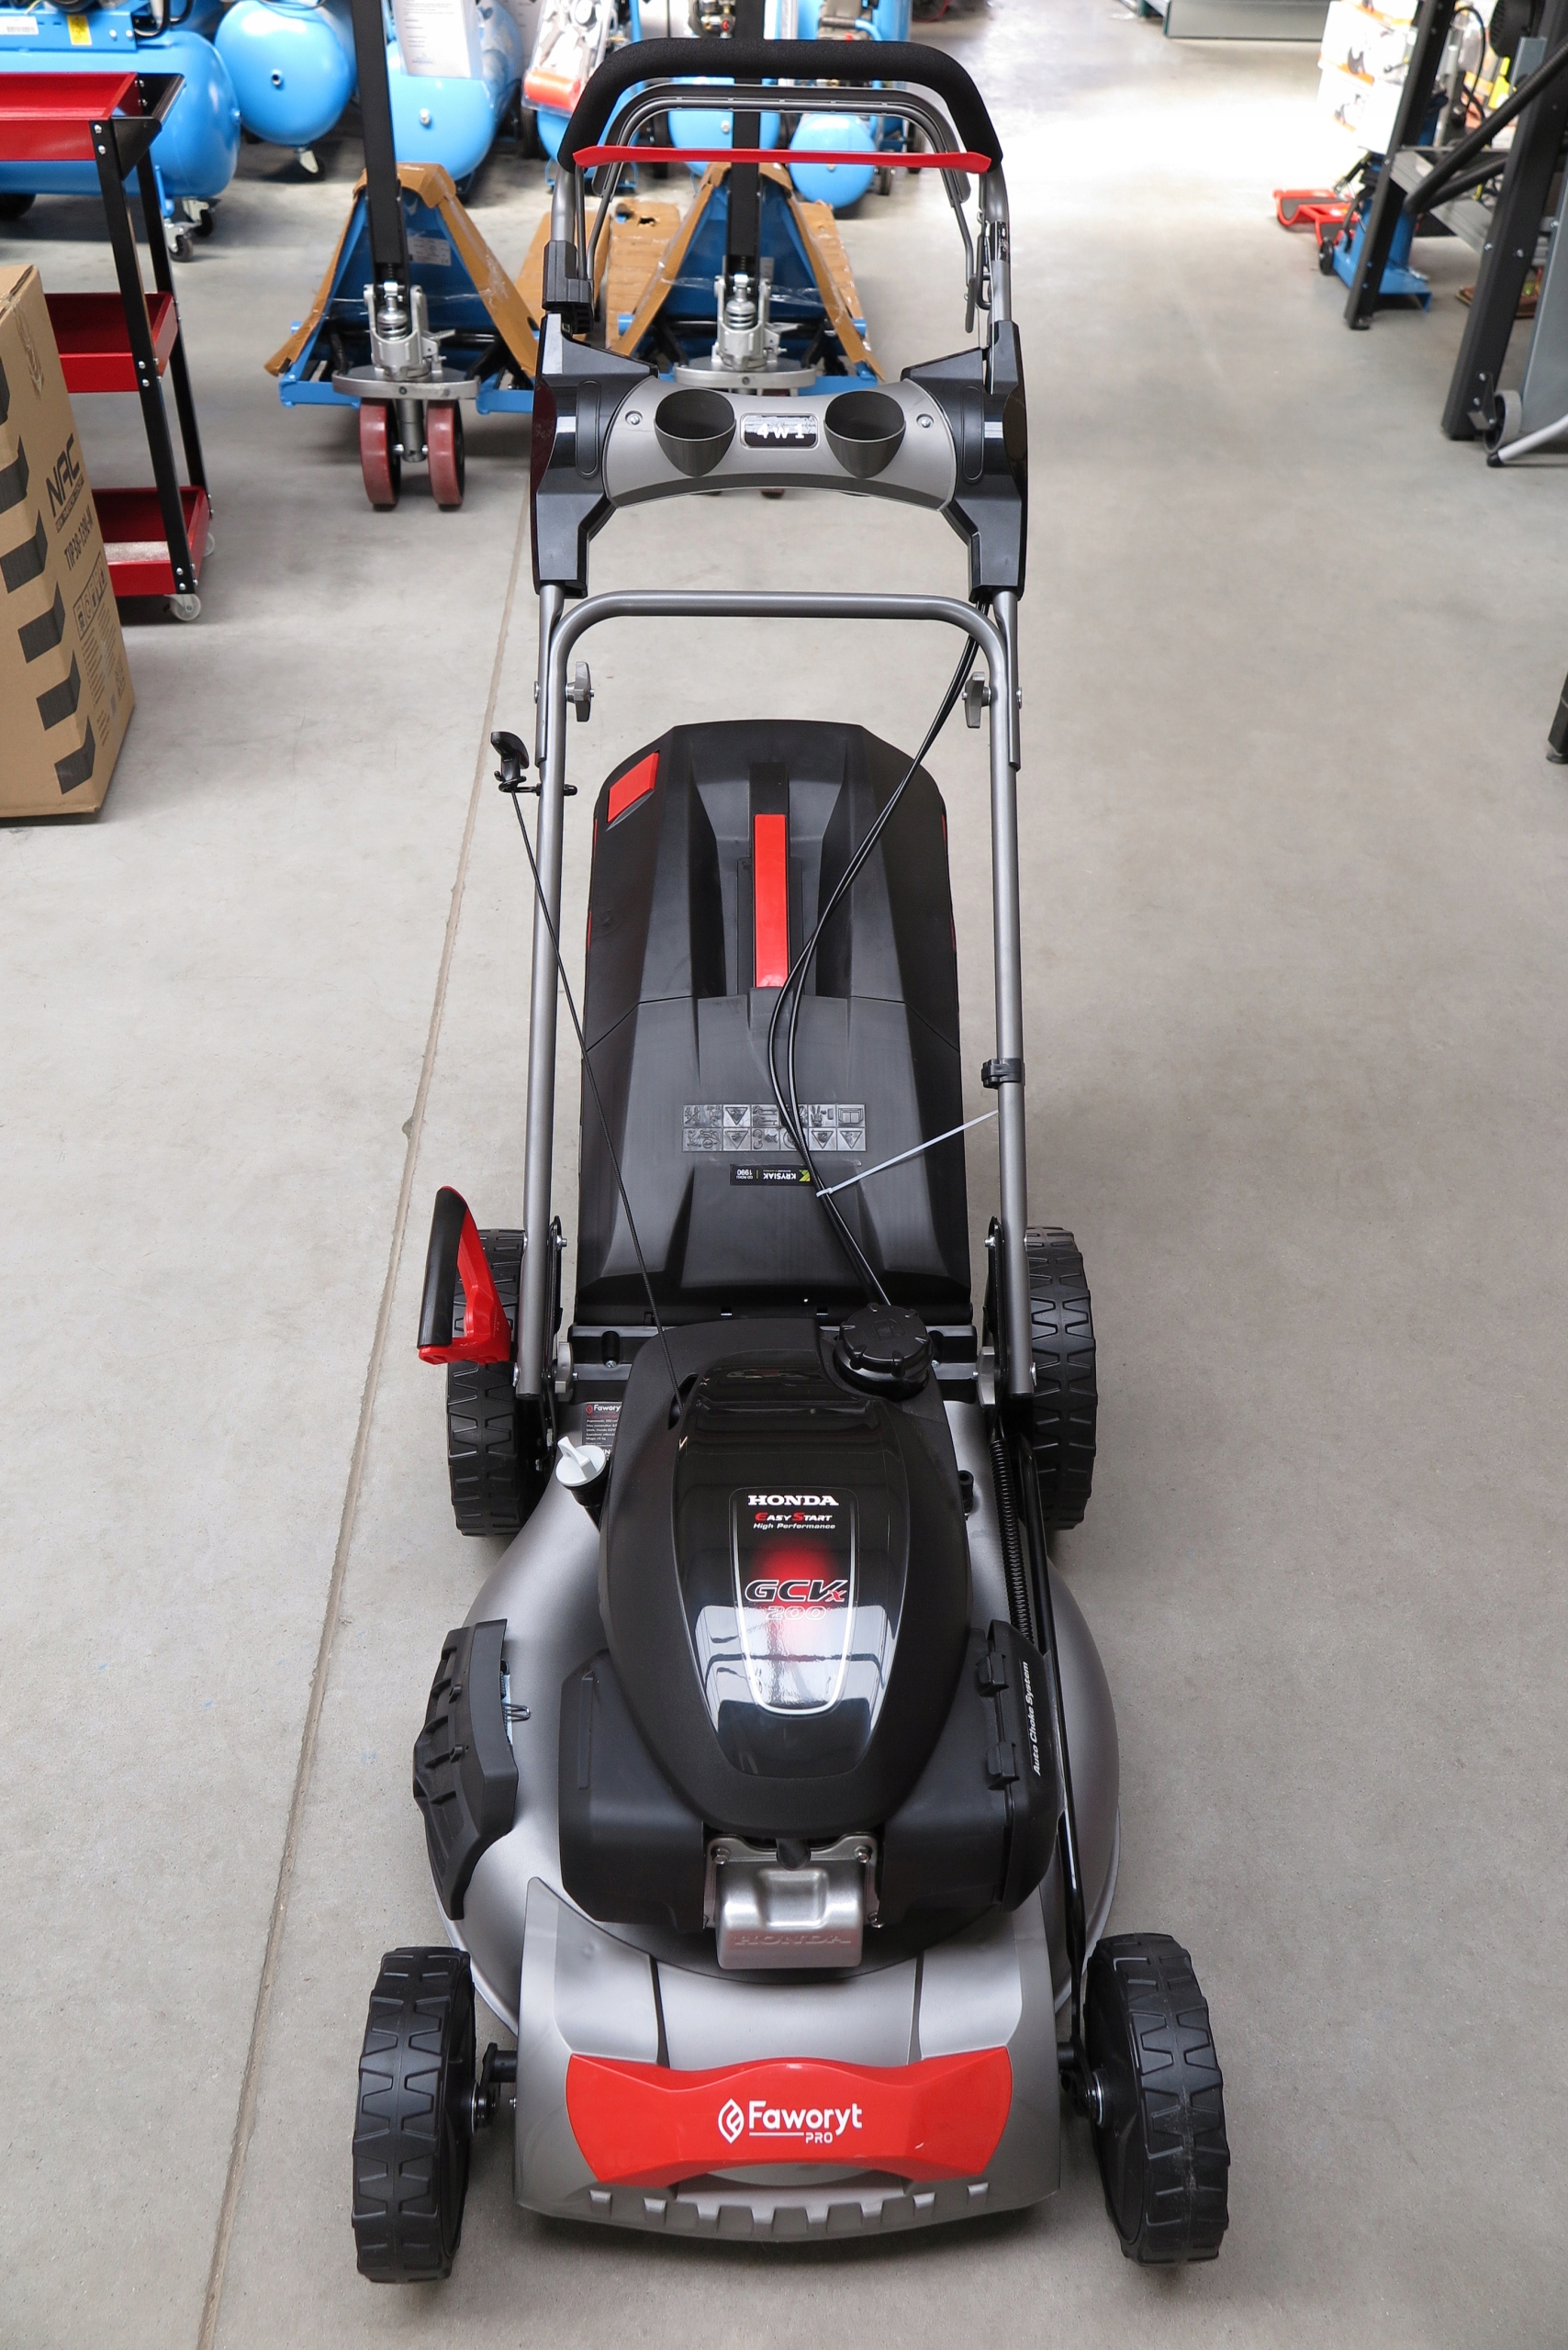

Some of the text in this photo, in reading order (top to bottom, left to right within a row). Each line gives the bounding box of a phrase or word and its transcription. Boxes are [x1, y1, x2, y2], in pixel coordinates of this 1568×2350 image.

[46, 432, 80, 518] NAC
[747, 1494, 839, 1505] HONDA
[766, 1606, 826, 1621] 200
[1022, 1661, 1041, 1777] Auto Choke System
[749, 2100, 862, 2136] Faworyt
[805, 2132, 834, 2143] PRO
